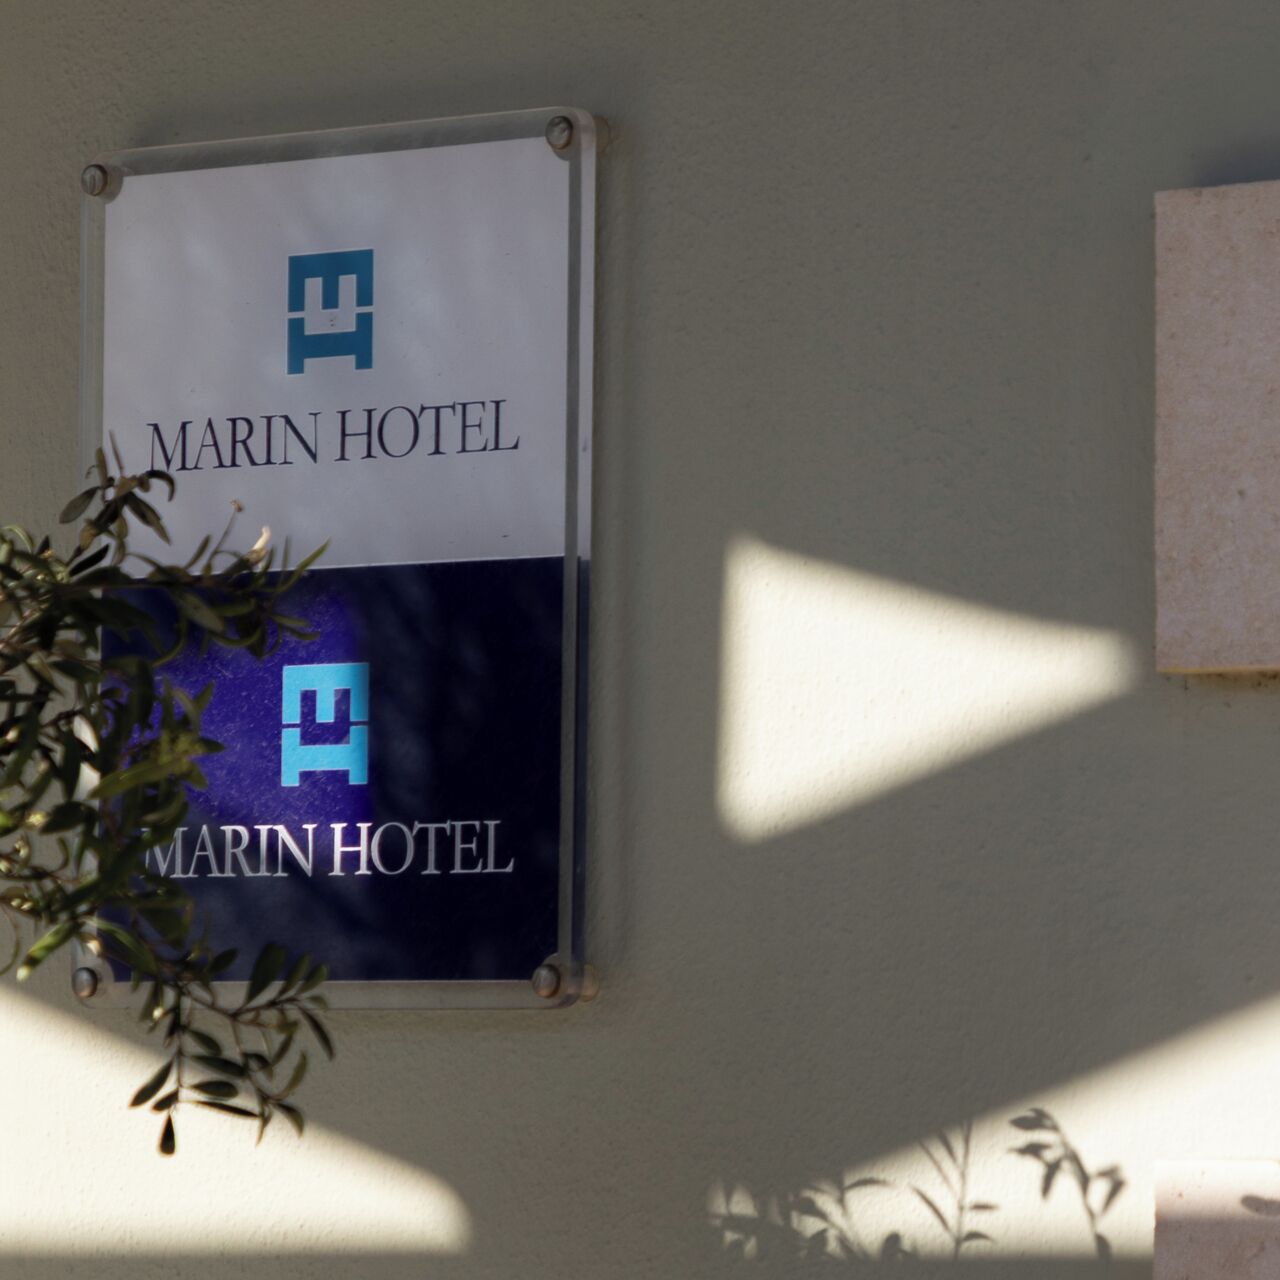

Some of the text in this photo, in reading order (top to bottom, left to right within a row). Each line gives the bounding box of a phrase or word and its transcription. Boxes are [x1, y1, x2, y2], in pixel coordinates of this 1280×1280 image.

[146, 399, 520, 472] MARIN HOTEL
[141, 819, 514, 878] MARIN HOTEL
